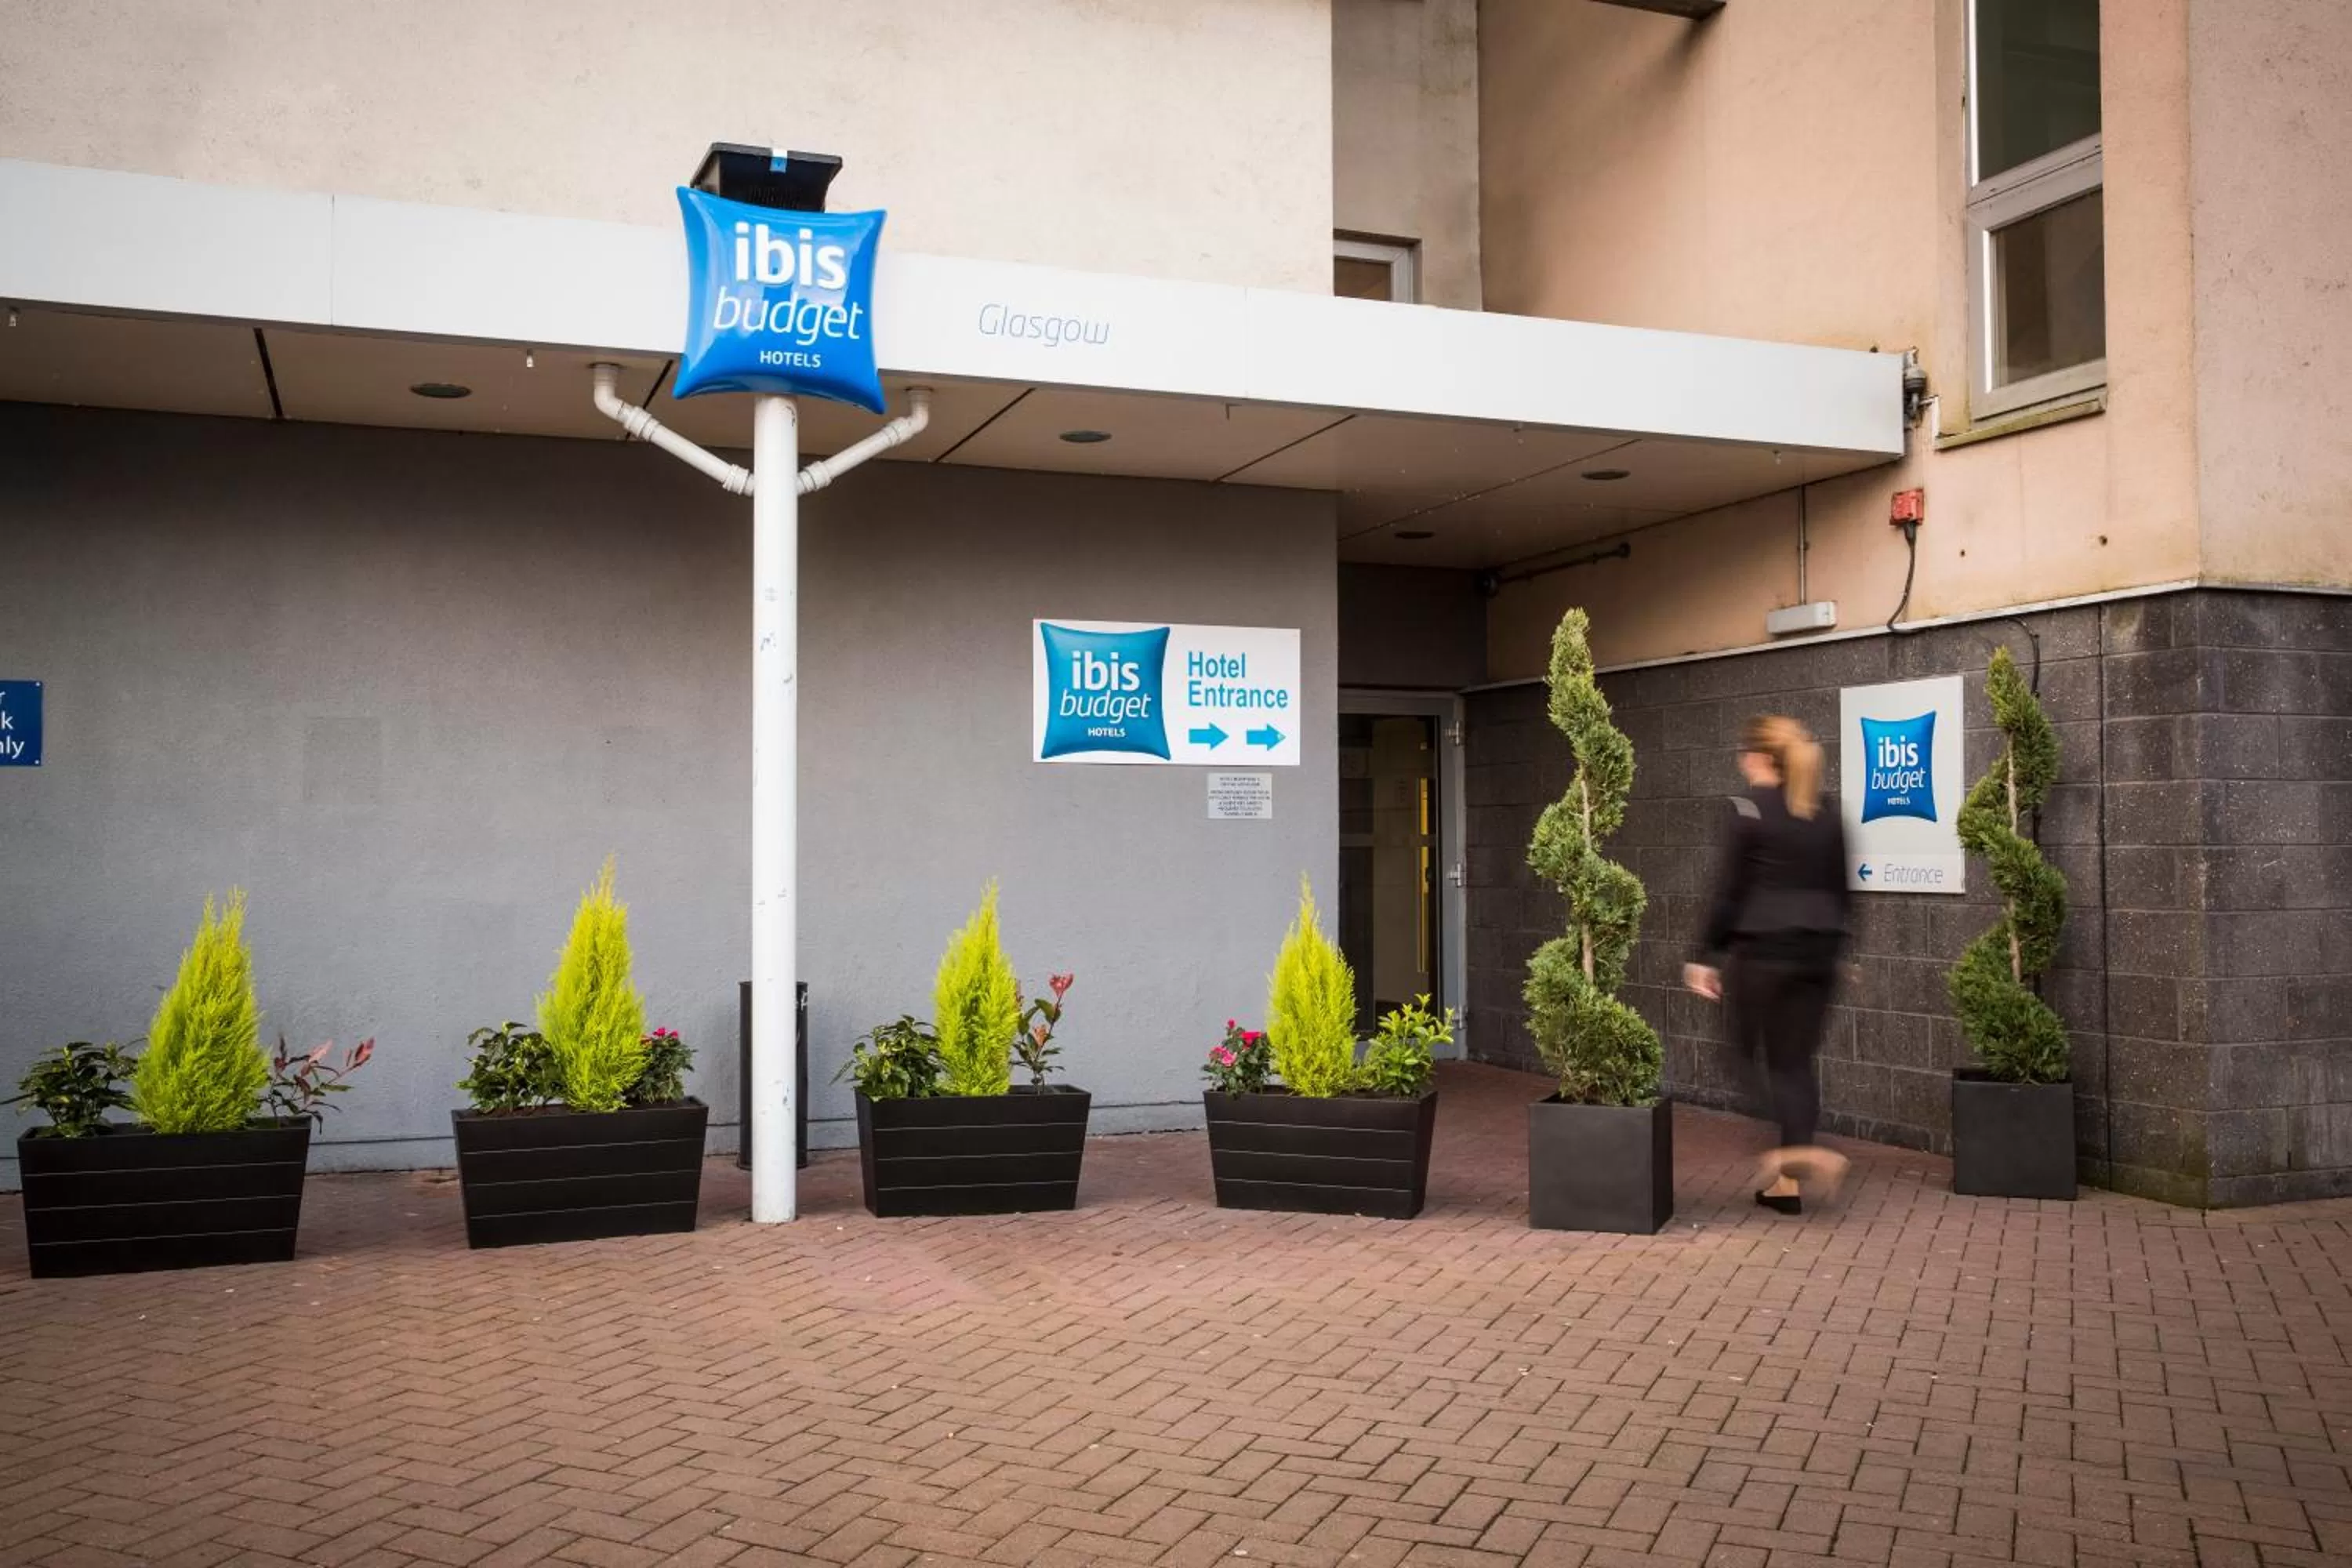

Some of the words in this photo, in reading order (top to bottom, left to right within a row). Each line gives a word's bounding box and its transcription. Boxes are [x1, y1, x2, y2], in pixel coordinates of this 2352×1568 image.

[735, 221, 846, 289] ibis
[713, 285, 863, 346] budget
[978, 303, 1110, 347] Glasgow
[760, 350, 822, 368] HOTELS
[1072, 651, 1141, 691] ibis
[1188, 651, 1246, 679] Hotel
[1060, 688, 1152, 724] budget
[1188, 681, 1289, 709] Entrance
[1087, 727, 1126, 738] HOTELS
[1878, 735, 1918, 768] ibis
[1871, 766, 1926, 794] budget
[1884, 863, 1944, 884] Entrance
